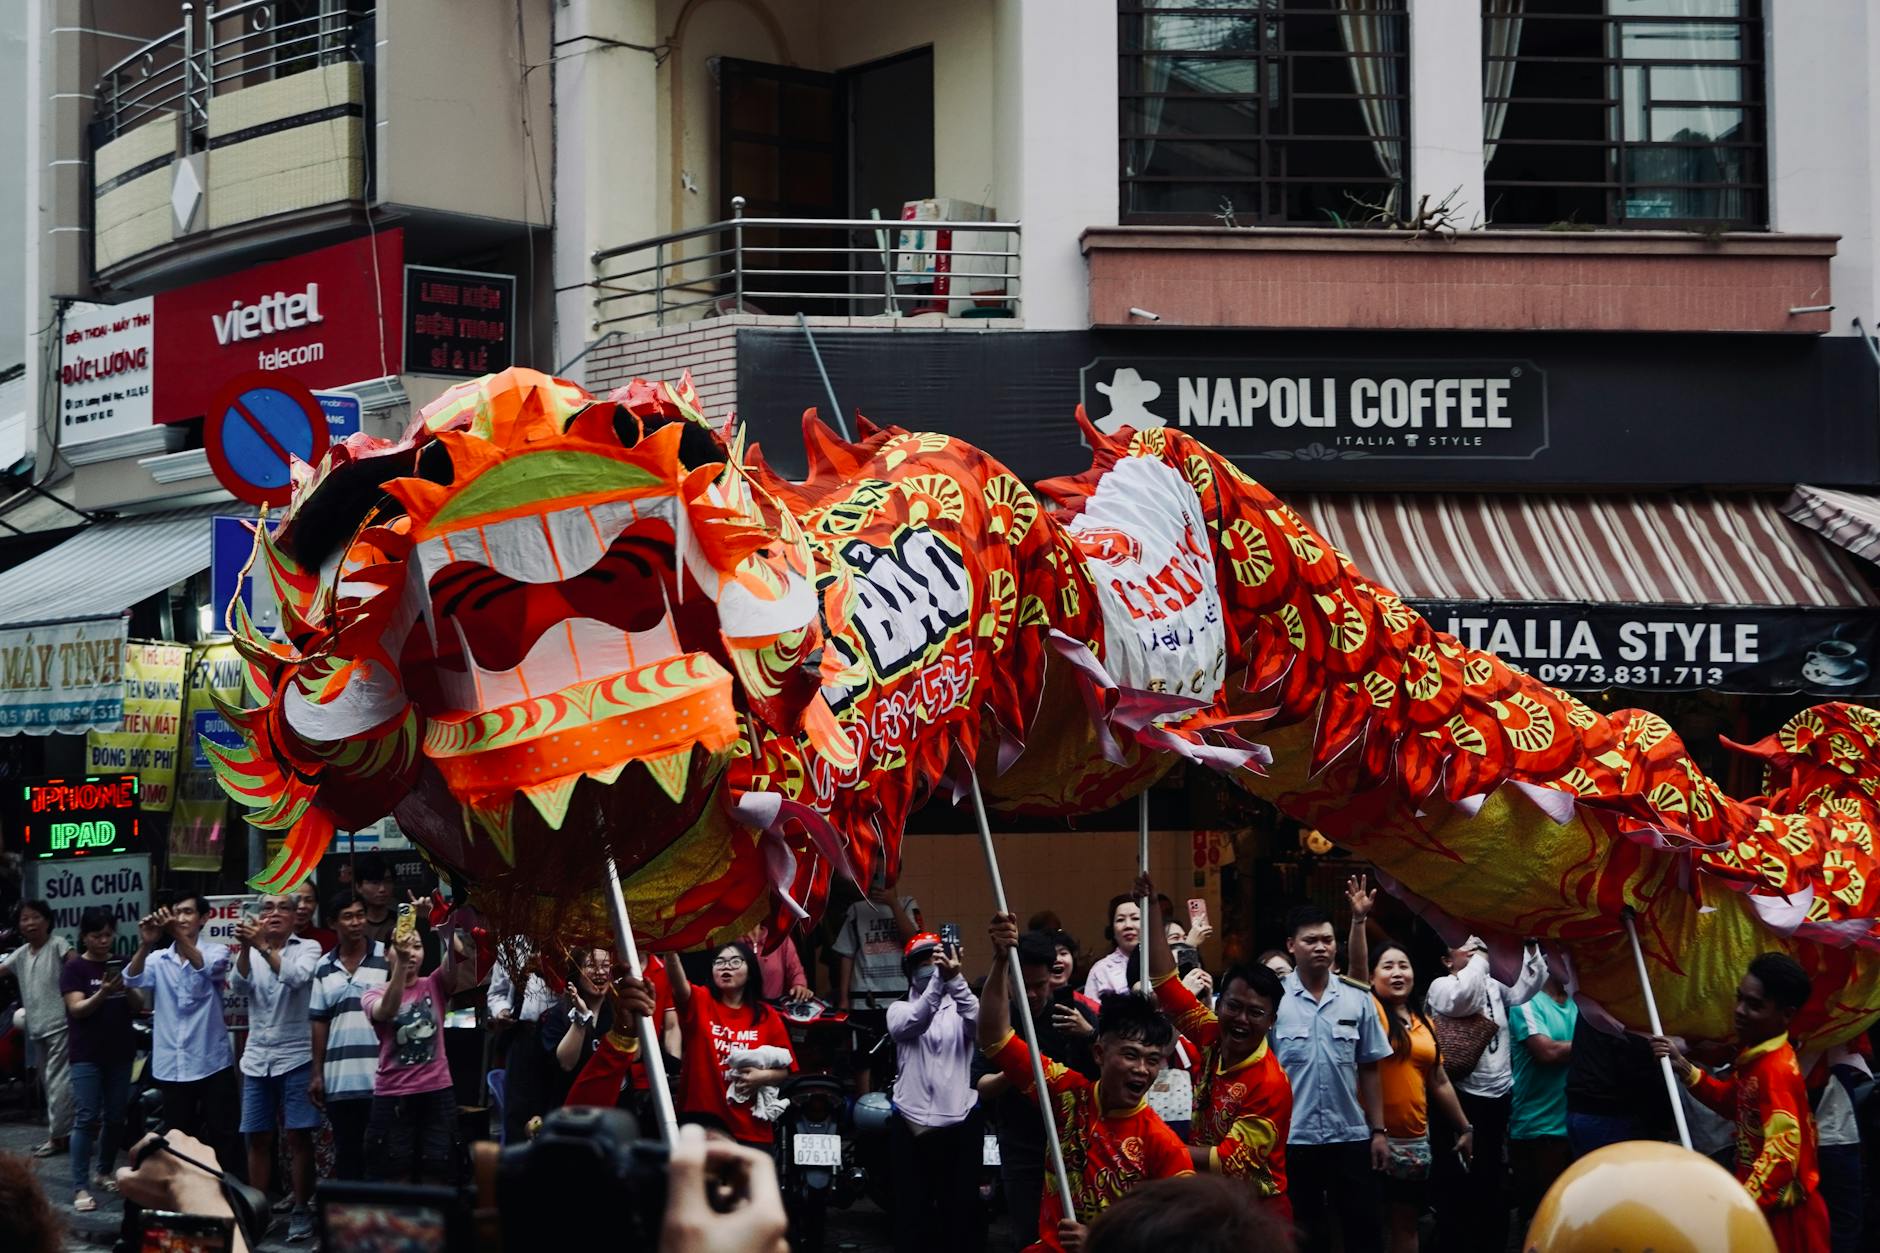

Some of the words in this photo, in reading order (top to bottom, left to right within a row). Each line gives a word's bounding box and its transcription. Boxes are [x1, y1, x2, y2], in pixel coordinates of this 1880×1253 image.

[212, 283, 323, 345] viettel
[259, 342, 324, 370] telecom
[1178, 377, 1336, 427] NAPOLI
[1350, 377, 1512, 428] COFFEE
[1336, 436, 1396, 446] ITALIA
[1429, 437, 1483, 446] STYLE
[1448, 618, 1602, 660] ITALIA
[1618, 622, 1759, 663] STYLE
[2, 632, 54, 690] MÁY
[60, 627, 122, 688] TÍNH
[1539, 664, 1723, 685] 0973.831.713
[92, 742, 126, 766] ĐÓNG
[154, 746, 175, 769] PHÍ
[51, 821, 116, 849] IPAD
[46, 870, 85, 899] SỬA
[91, 867, 143, 895] CHỮA
[395, 863, 423, 875] OFFEE
[737, 1030, 758, 1041] ME
